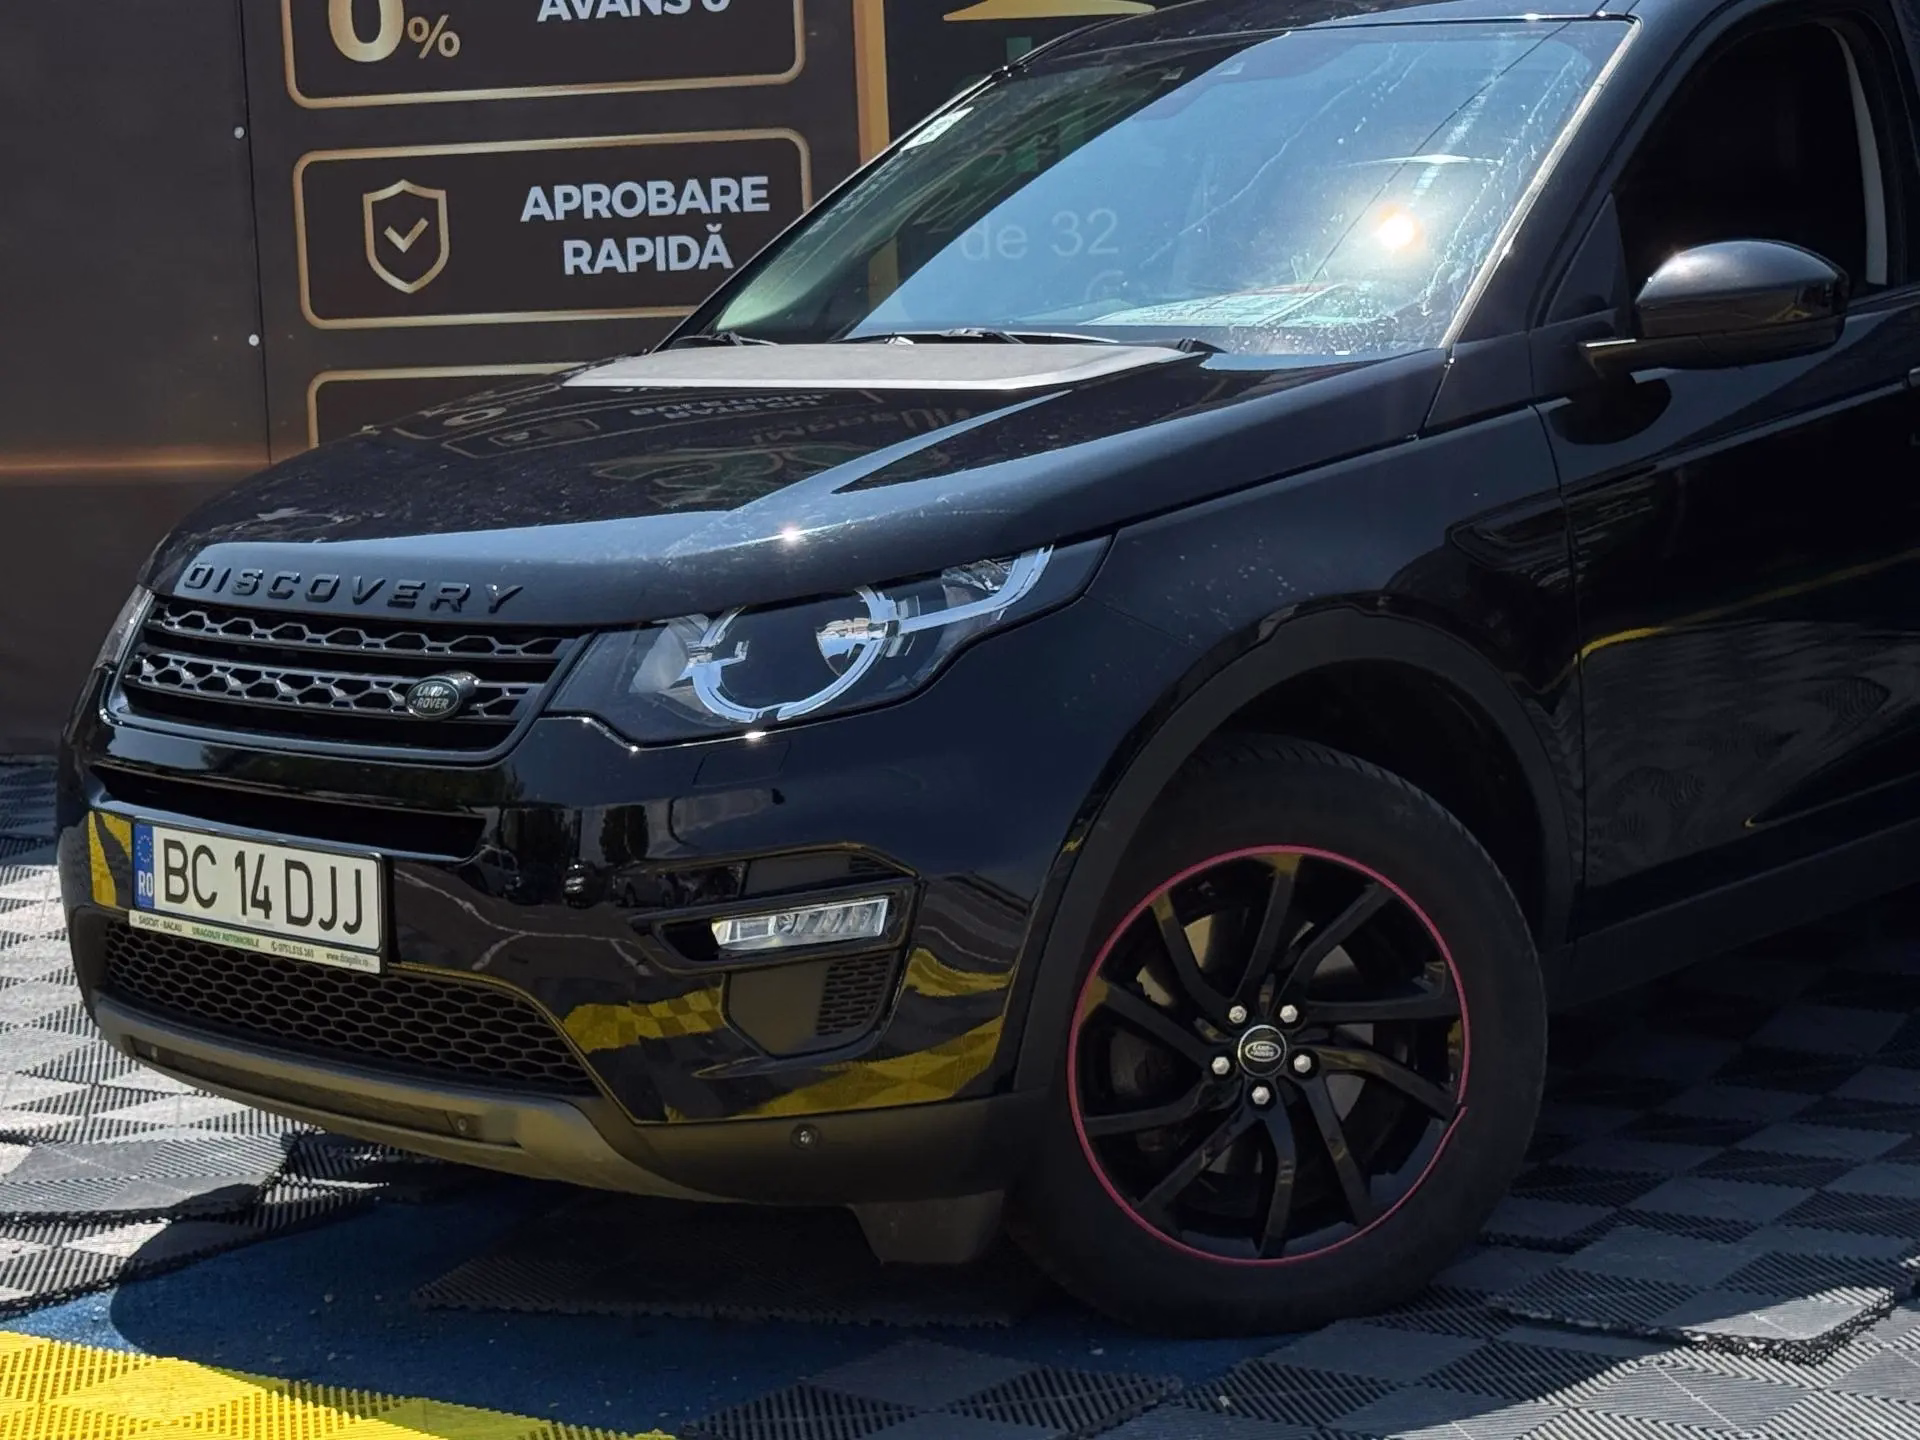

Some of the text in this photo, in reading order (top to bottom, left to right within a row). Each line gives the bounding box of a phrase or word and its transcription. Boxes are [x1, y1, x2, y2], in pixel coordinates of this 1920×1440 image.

[520, 176, 770, 222] APROBARE
[563, 223, 734, 275] RAPIDĂ
[1051, 208, 1119, 257] 32
[184, 562, 524, 614] DISCOVERY
[416, 686, 444, 697] LAND
[416, 697, 449, 710] ROVER
[138, 870, 154, 897] RO
[163, 838, 363, 935] BC 14 DJJ
